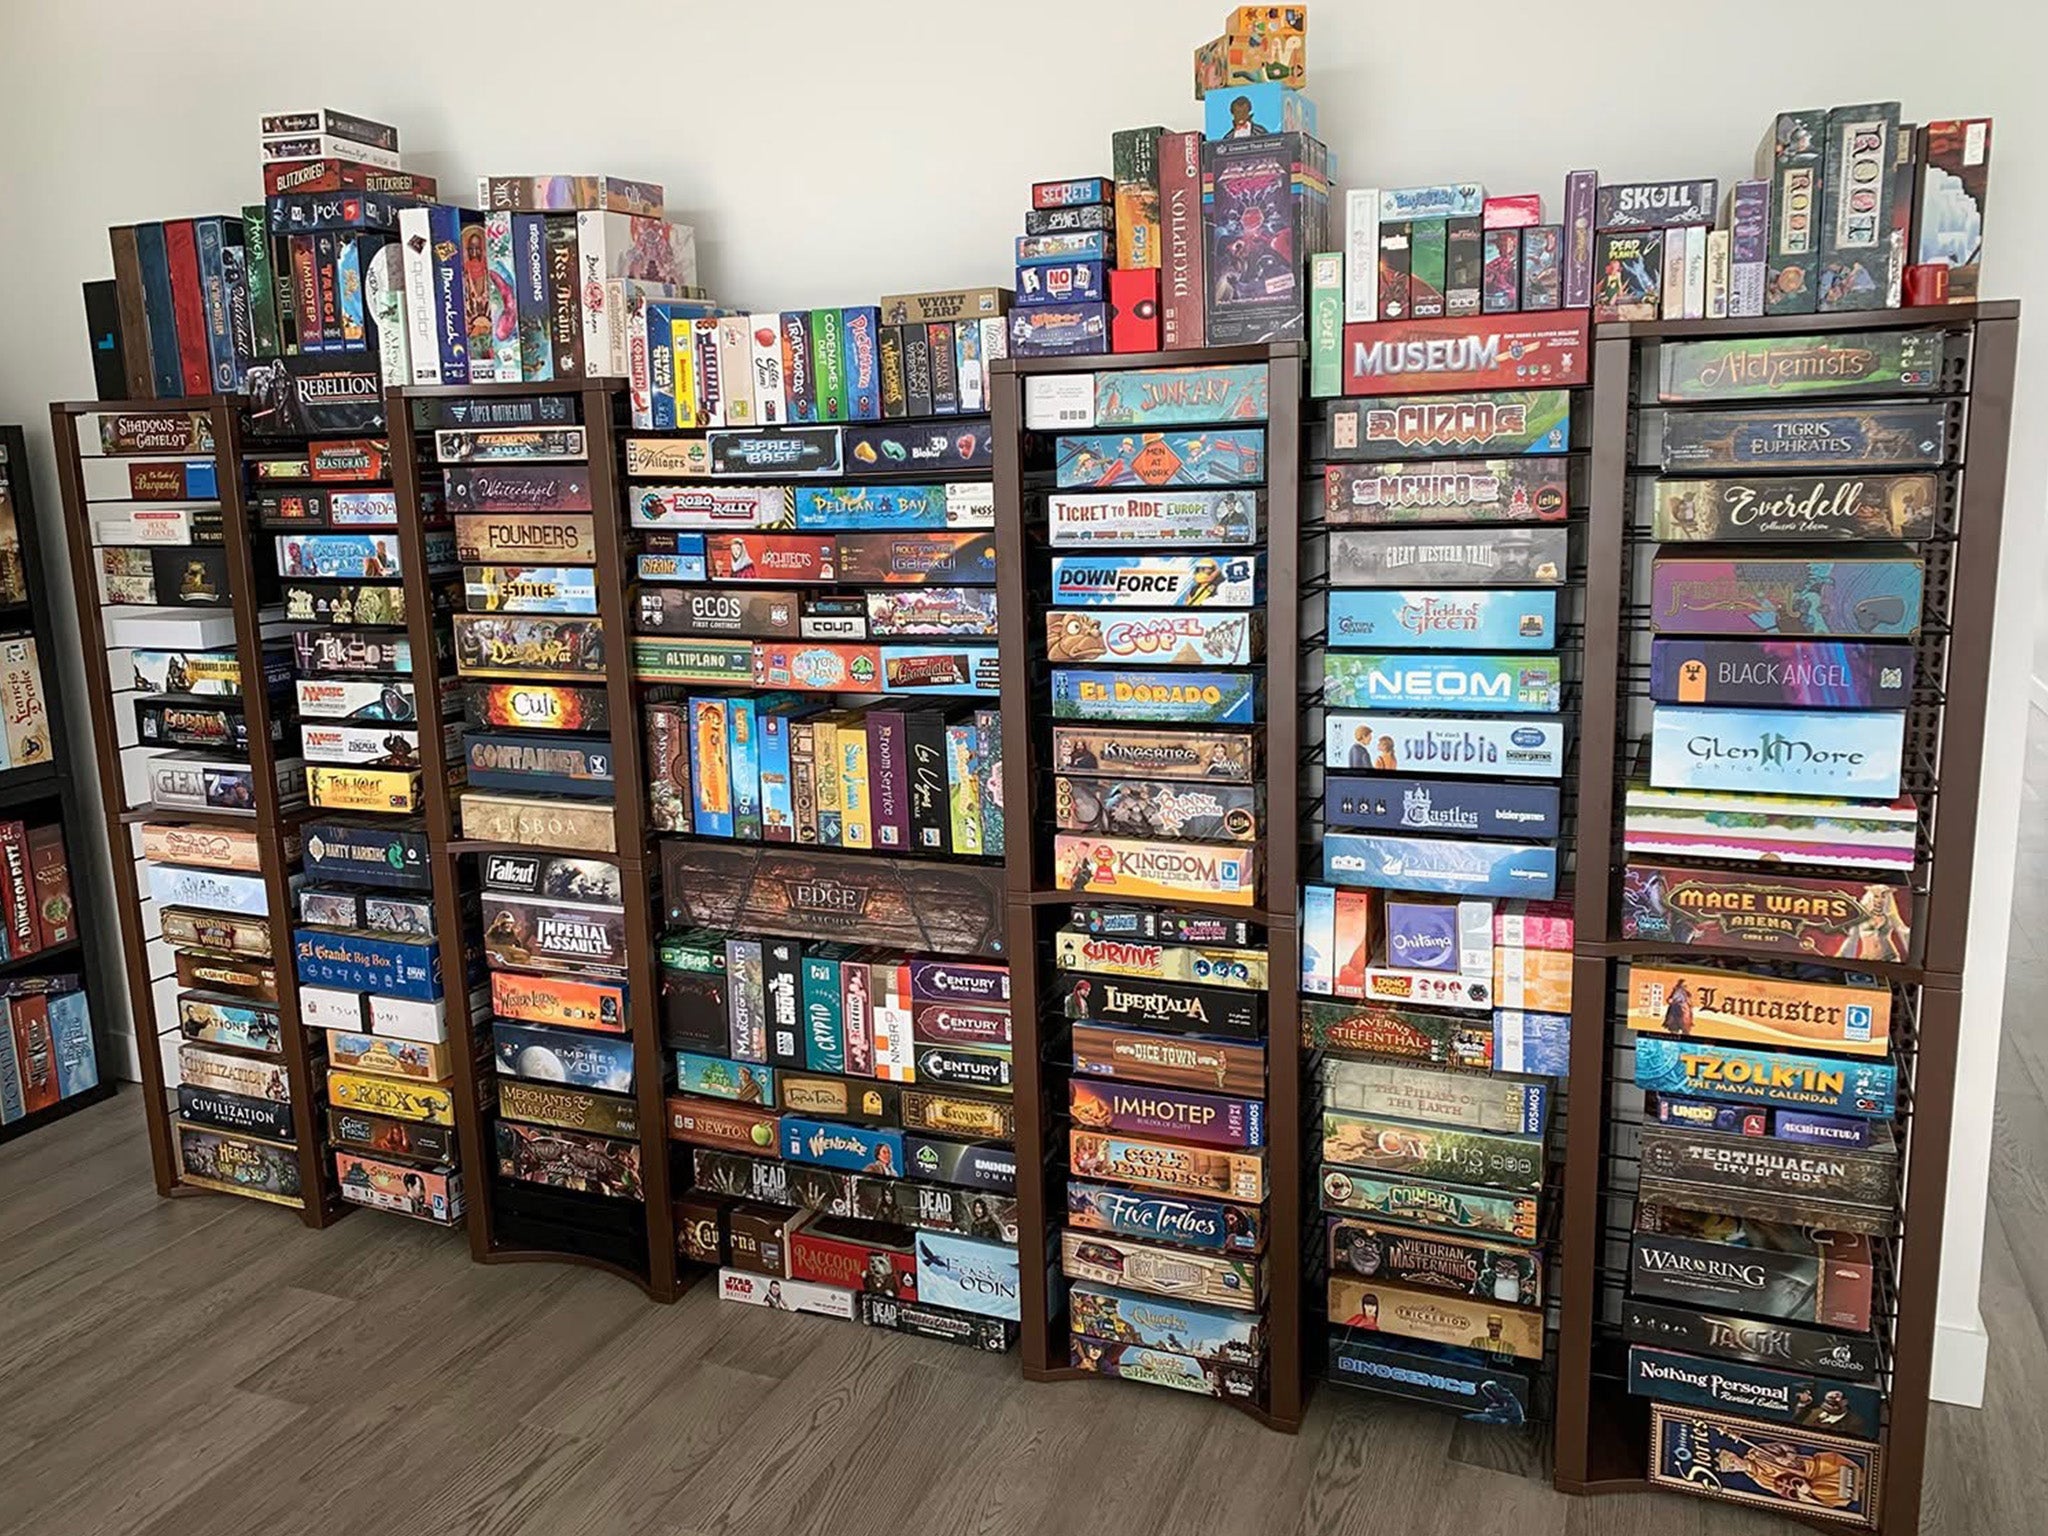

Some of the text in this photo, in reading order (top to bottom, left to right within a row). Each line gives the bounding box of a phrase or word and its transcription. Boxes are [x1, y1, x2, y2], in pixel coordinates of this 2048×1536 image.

[277, 162, 325, 191] BLITZKRIEG!
[366, 176, 413, 192] BLITZKRIEG!
[1850, 124, 1884, 245] ROOT
[1042, 184, 1091, 203] SECRETS
[1619, 186, 1692, 211] SKULL
[1790, 172, 1809, 251] ROOT
[1172, 189, 1188, 297] DECEPTION
[1610, 239, 1639, 251] DEAD
[1049, 270, 1069, 284] NO
[302, 261, 317, 322] IMHOTEP
[322, 264, 334, 322] TARGI
[412, 261, 429, 339] quoridor
[554, 248, 571, 343] Res Arcana
[917, 296, 966, 307] WYATT
[923, 306, 961, 318] EARP
[631, 337, 646, 390] CORINTH
[787, 317, 806, 394] TRAPWORDS
[818, 341, 826, 366] DUET
[824, 314, 837, 391] CODENAMES
[1354, 334, 1501, 377] MUSEUM
[1702, 349, 1871, 388] Alchemists
[297, 376, 377, 397] REBELLION
[1141, 378, 1233, 410] JUNK ART
[118, 418, 174, 435] SHADOWS
[1401, 405, 1492, 442] CUZCO
[1773, 423, 1830, 437] TIGRIS
[136, 434, 187, 448] CAMELOT
[477, 434, 543, 444] STEAMPUNK
[743, 440, 802, 451] SPACE
[931, 437, 948, 450] 3D
[1751, 438, 1851, 454] EUPHRATES
[750, 451, 798, 463] BASE
[1146, 447, 1166, 456] MEN
[1142, 469, 1169, 477] WORK
[134, 474, 180, 497] Burgundy
[478, 478, 556, 497] Whitechapel
[339, 504, 396, 516] PAGODA
[675, 494, 712, 507] ROBO
[711, 501, 755, 517] RALLY
[815, 495, 927, 515] PELICAN BAY
[1056, 500, 1208, 521] TICKET TO RIDE EUROPE
[1724, 482, 1863, 525] Everdell
[489, 525, 578, 548] FOUNDERS
[762, 552, 811, 567] ARCHITECTS
[1387, 546, 1494, 568] GREAT WESTERN TRAIL
[1059, 569, 1117, 585] DOWN
[1117, 576, 1178, 592] FORCE
[692, 597, 741, 617] ecos
[1421, 598, 1479, 616] Fields of
[813, 621, 853, 633] COUP
[1402, 605, 1477, 635] Green
[315, 638, 348, 662] Tak
[667, 652, 725, 668] ALTIPLANO
[1369, 670, 1512, 697] NEOM
[1719, 662, 1849, 687] BLACK ANGEL
[302, 686, 344, 704] MAGIC
[510, 692, 557, 716] Cult
[1080, 682, 1220, 704] EL DORADO
[306, 732, 343, 746] MAGIC
[1405, 731, 1497, 763] suburbia
[471, 744, 586, 773] CONTAINER
[1104, 743, 1196, 762] KINGSBURG
[879, 725, 893, 816] Broom Service
[1156, 790, 1216, 810] BUNNY
[497, 818, 577, 835] LISBOA
[1160, 805, 1223, 828] KINGDOM
[490, 859, 534, 883] Fallout
[1117, 851, 1218, 882] KINGDOM
[1141, 870, 1191, 882] BUILDER
[6, 843, 31, 937] DUNGEON PETZ
[798, 886, 856, 906] EDGE
[1679, 889, 1848, 917] MAGE WARS
[1731, 915, 1793, 931] ARENA
[200, 935, 231, 947] WORLD
[538, 920, 611, 949] IMPERIAL
[545, 936, 602, 954] ASSAULT
[298, 943, 391, 967] El Grande Big Box
[681, 951, 710, 968] FEAR
[733, 946, 746, 980] ANTS
[1083, 940, 1163, 967] SURVIVE
[934, 970, 995, 988] CENTURY
[1377, 977, 1407, 987] DINO
[779, 973, 795, 1024] CROWS
[1372, 985, 1412, 996] WORLD
[1103, 986, 1209, 1023] LIBERTALIA
[1697, 988, 1841, 1025] Lancaster
[737, 1007, 750, 1054] MARCH
[817, 1003, 835, 1051] CRYPTID
[937, 1013, 998, 1031] CENTURY
[1350, 1018, 1410, 1036] TAVERNS
[555, 1048, 617, 1065] EMPIRES
[928, 1055, 999, 1076] CENTURY
[1135, 1044, 1197, 1066] DICE TOWN
[185, 1058, 266, 1086] CIVILIZATION
[1681, 1054, 1844, 1095] TZOLK'IN
[355, 1086, 411, 1111] REX
[505, 1086, 571, 1107] MERCHANTS
[193, 1098, 274, 1124] CIVILIZATION
[514, 1102, 585, 1124] MARAUDERS
[940, 1104, 987, 1125] Troyes
[1114, 1096, 1215, 1125] IMHOTEP
[1529, 1088, 1540, 1132] KOSMOS
[1672, 1104, 1717, 1121] UNDO
[696, 1121, 749, 1139] NEWTON
[1250, 1104, 1258, 1145] KOSMOS
[219, 1145, 260, 1164] HEROES
[808, 1135, 867, 1158] WENDAKE
[1379, 1131, 1483, 1167] CAYLUS
[975, 1160, 1016, 1174] EMINEN
[1689, 1146, 1845, 1177] TEOTIHUACAN
[753, 1165, 785, 1188] DEAD
[975, 1172, 1013, 1183] DOMAI
[919, 1190, 952, 1212] DEAD
[1392, 1187, 1456, 1216] COIMBRA
[696, 1220, 756, 1251] Cavrna
[795, 1244, 862, 1275] RACCOON
[1403, 1239, 1464, 1260] VICTORIAN
[1390, 1247, 1477, 1280] MASTERMINDS
[1640, 1248, 1767, 1287] WAR RING
[727, 1276, 752, 1287] STAR
[960, 1278, 1016, 1298] ODIN
[873, 1301, 897, 1318] DEAD
[1399, 1308, 1467, 1327] TRICKERION
[1338, 1356, 1476, 1395] DINOGENICS
[1640, 1362, 1788, 1401] Nothing Personal
